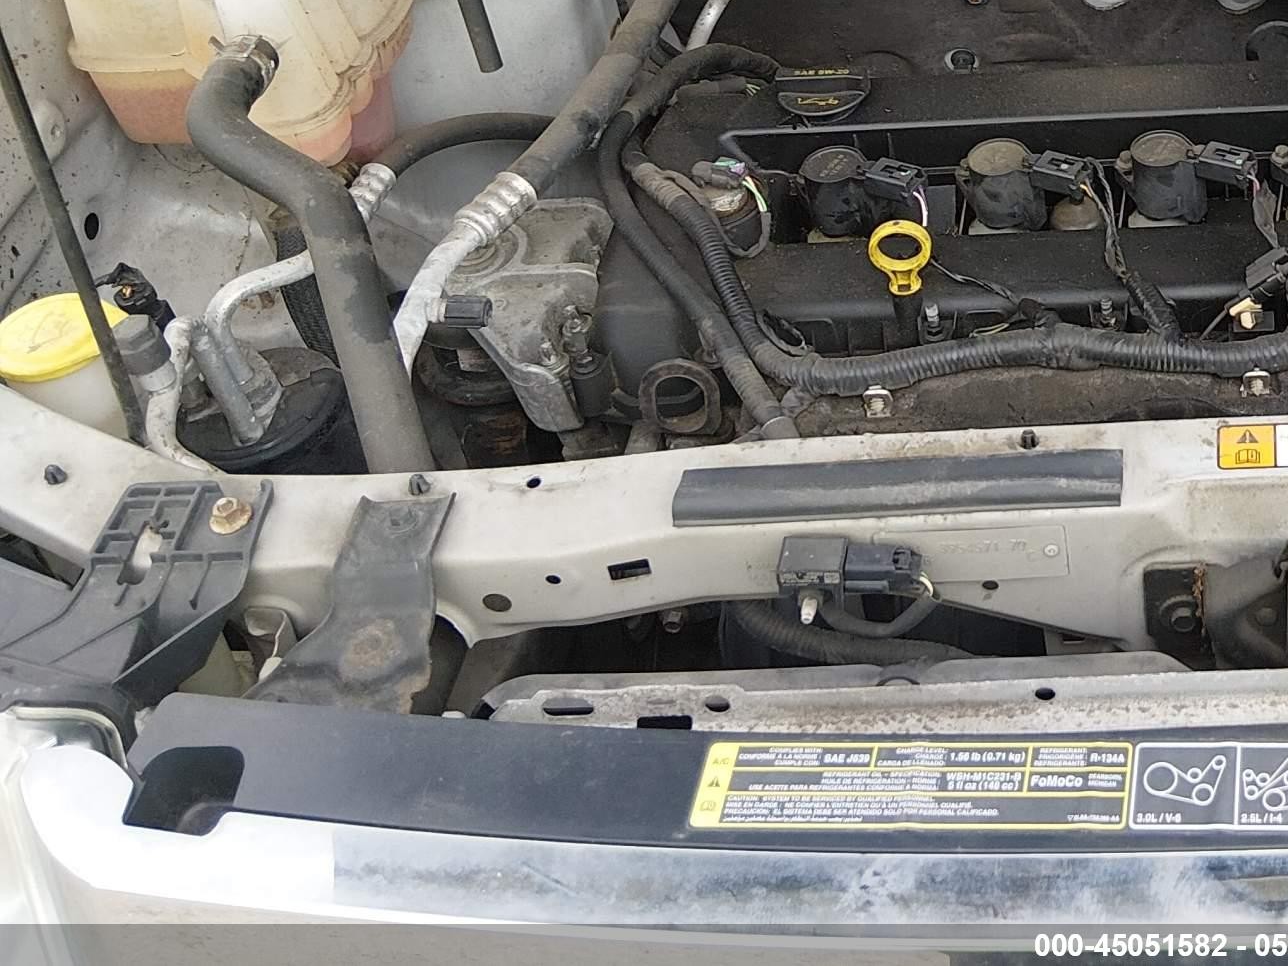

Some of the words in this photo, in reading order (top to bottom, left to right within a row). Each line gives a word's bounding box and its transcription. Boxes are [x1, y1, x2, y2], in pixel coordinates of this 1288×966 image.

[823, 753, 846, 764] SAE
[970, 751, 981, 762] lb
[982, 750, 1007, 763] (0.71
[1007, 750, 1026, 764] kg)
[1089, 752, 1126, 764] R-134A
[1030, 774, 1083, 788] FoMoCo
[1136, 812, 1158, 823] 3.0L
